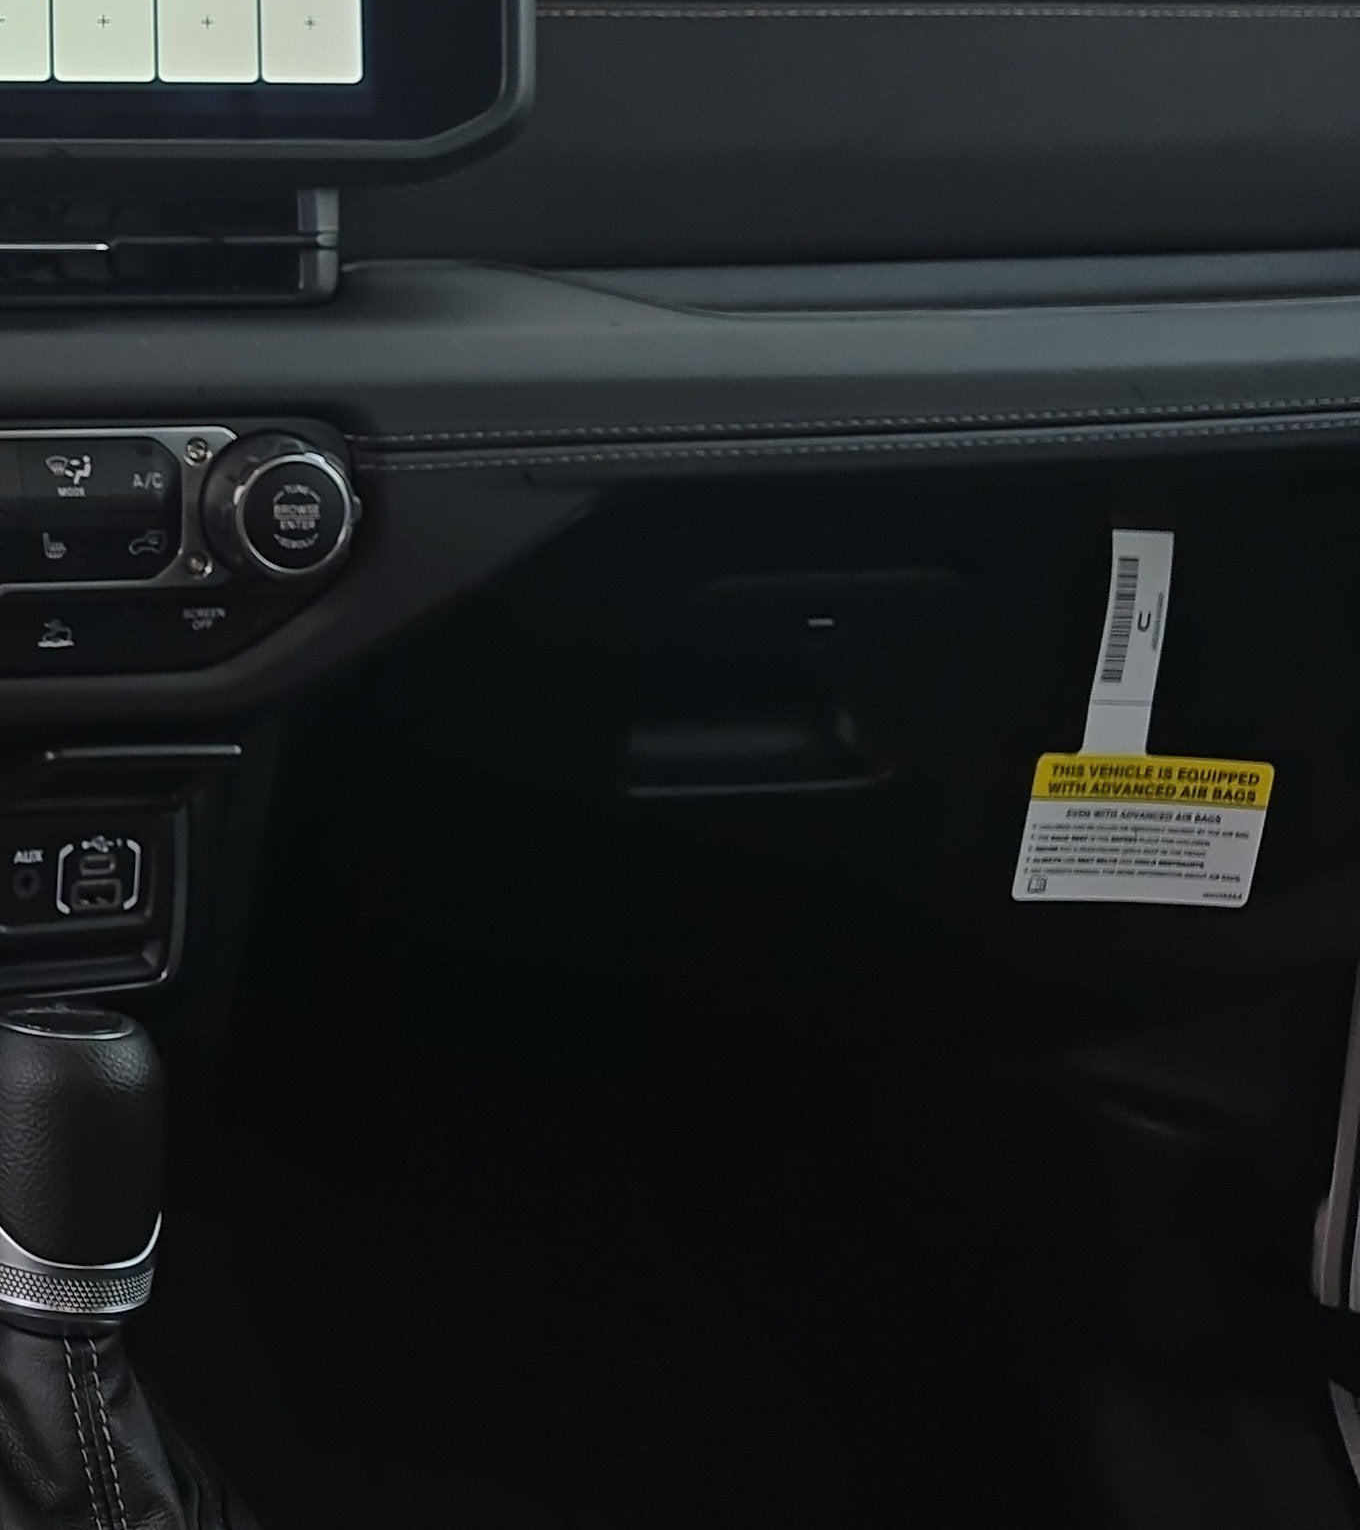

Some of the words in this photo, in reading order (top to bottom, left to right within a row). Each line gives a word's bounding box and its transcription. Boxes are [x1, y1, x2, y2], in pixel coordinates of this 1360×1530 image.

[132, 472, 164, 489] A/C
[1051, 762, 1086, 778] THIS
[1089, 763, 1153, 781] VEHICLE
[1157, 765, 1173, 780] IS
[1176, 766, 1261, 787] EQUIPPED
[1047, 780, 1087, 796] WITH
[1089, 782, 1177, 799] ADVANCED
[1179, 784, 1208, 801] AIR
[1211, 786, 1257, 803] BAGS
[13, 849, 43, 864] AUX
